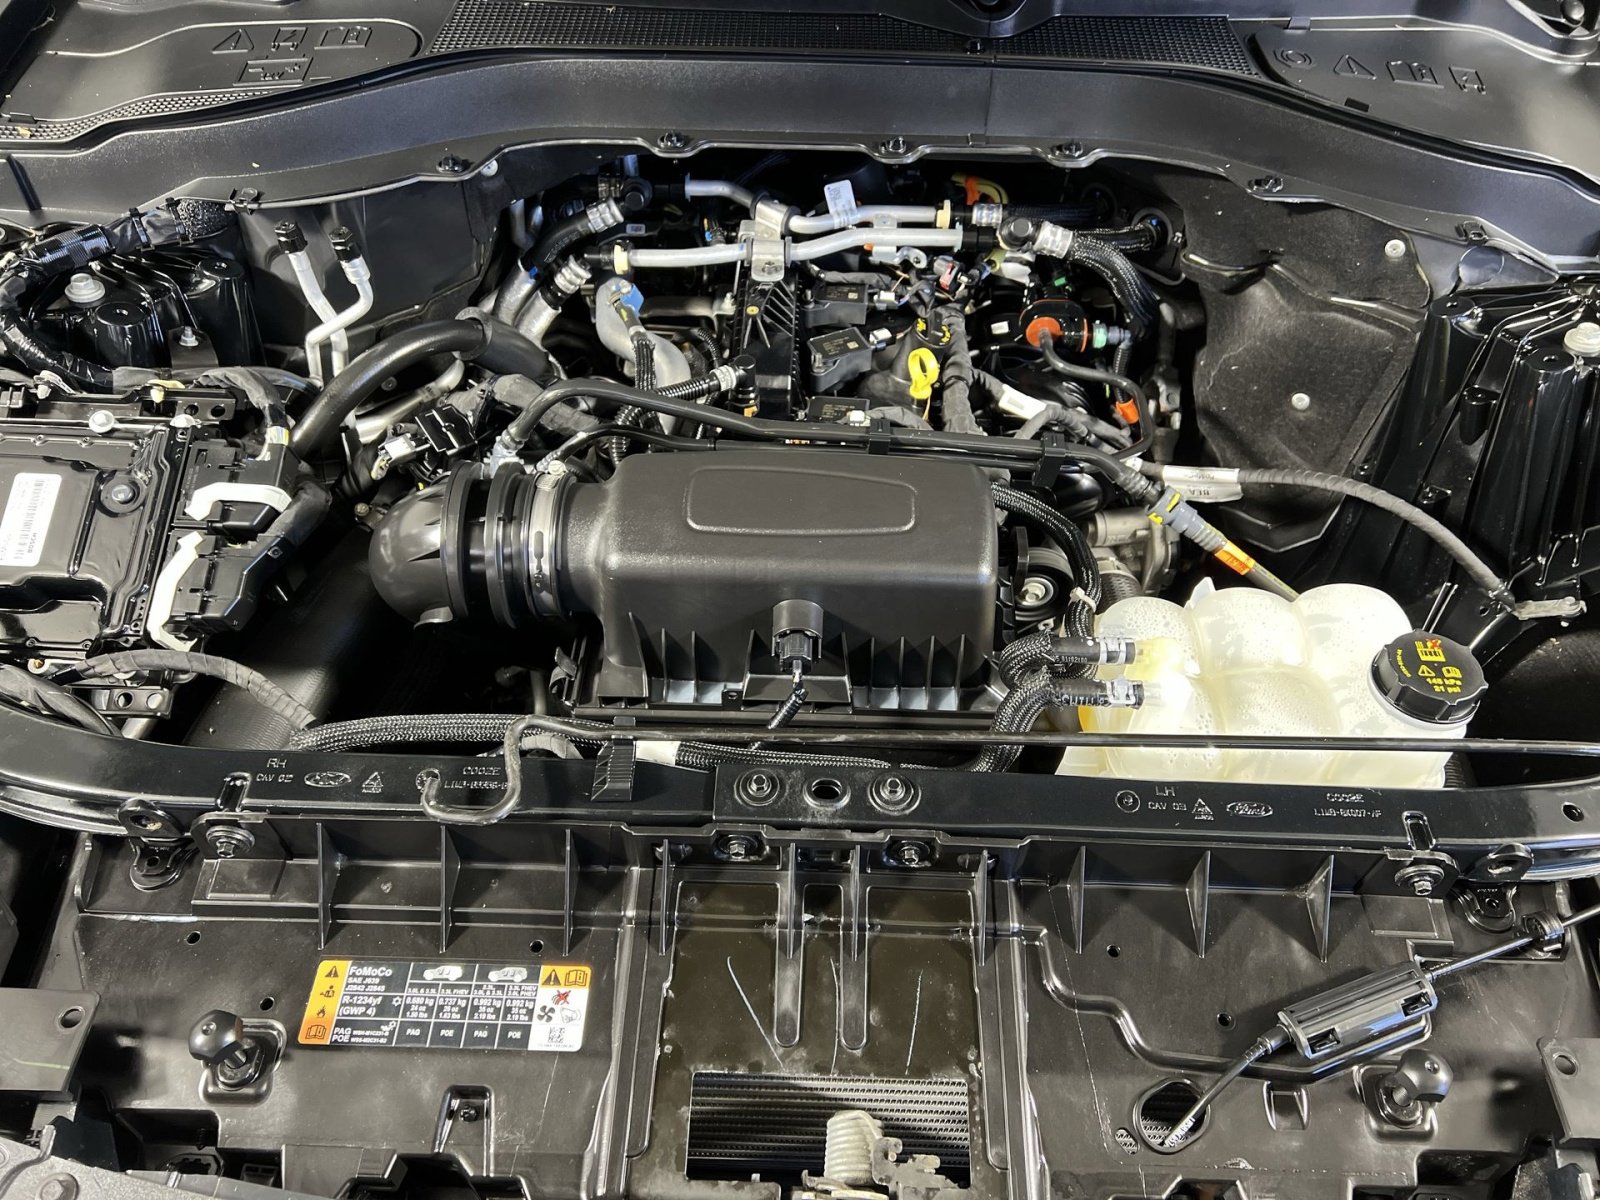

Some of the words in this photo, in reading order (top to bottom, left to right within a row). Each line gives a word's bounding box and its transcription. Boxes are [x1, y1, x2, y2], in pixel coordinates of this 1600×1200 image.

[27, 532, 38, 554] BOSCH
[266, 758, 287, 768] RH
[1155, 785, 1176, 796] LH
[1148, 801, 1167, 810] CAV
[348, 967, 392, 977] FoMoCo
[342, 996, 383, 1006] R-1234yf
[425, 997, 434, 1006] kg
[457, 998, 466, 1007] kg
[492, 998, 501, 1008] kg
[525, 1000, 534, 1009] kg
[339, 1006, 366, 1016] (GWP
[366, 1007, 376, 1017] 4)
